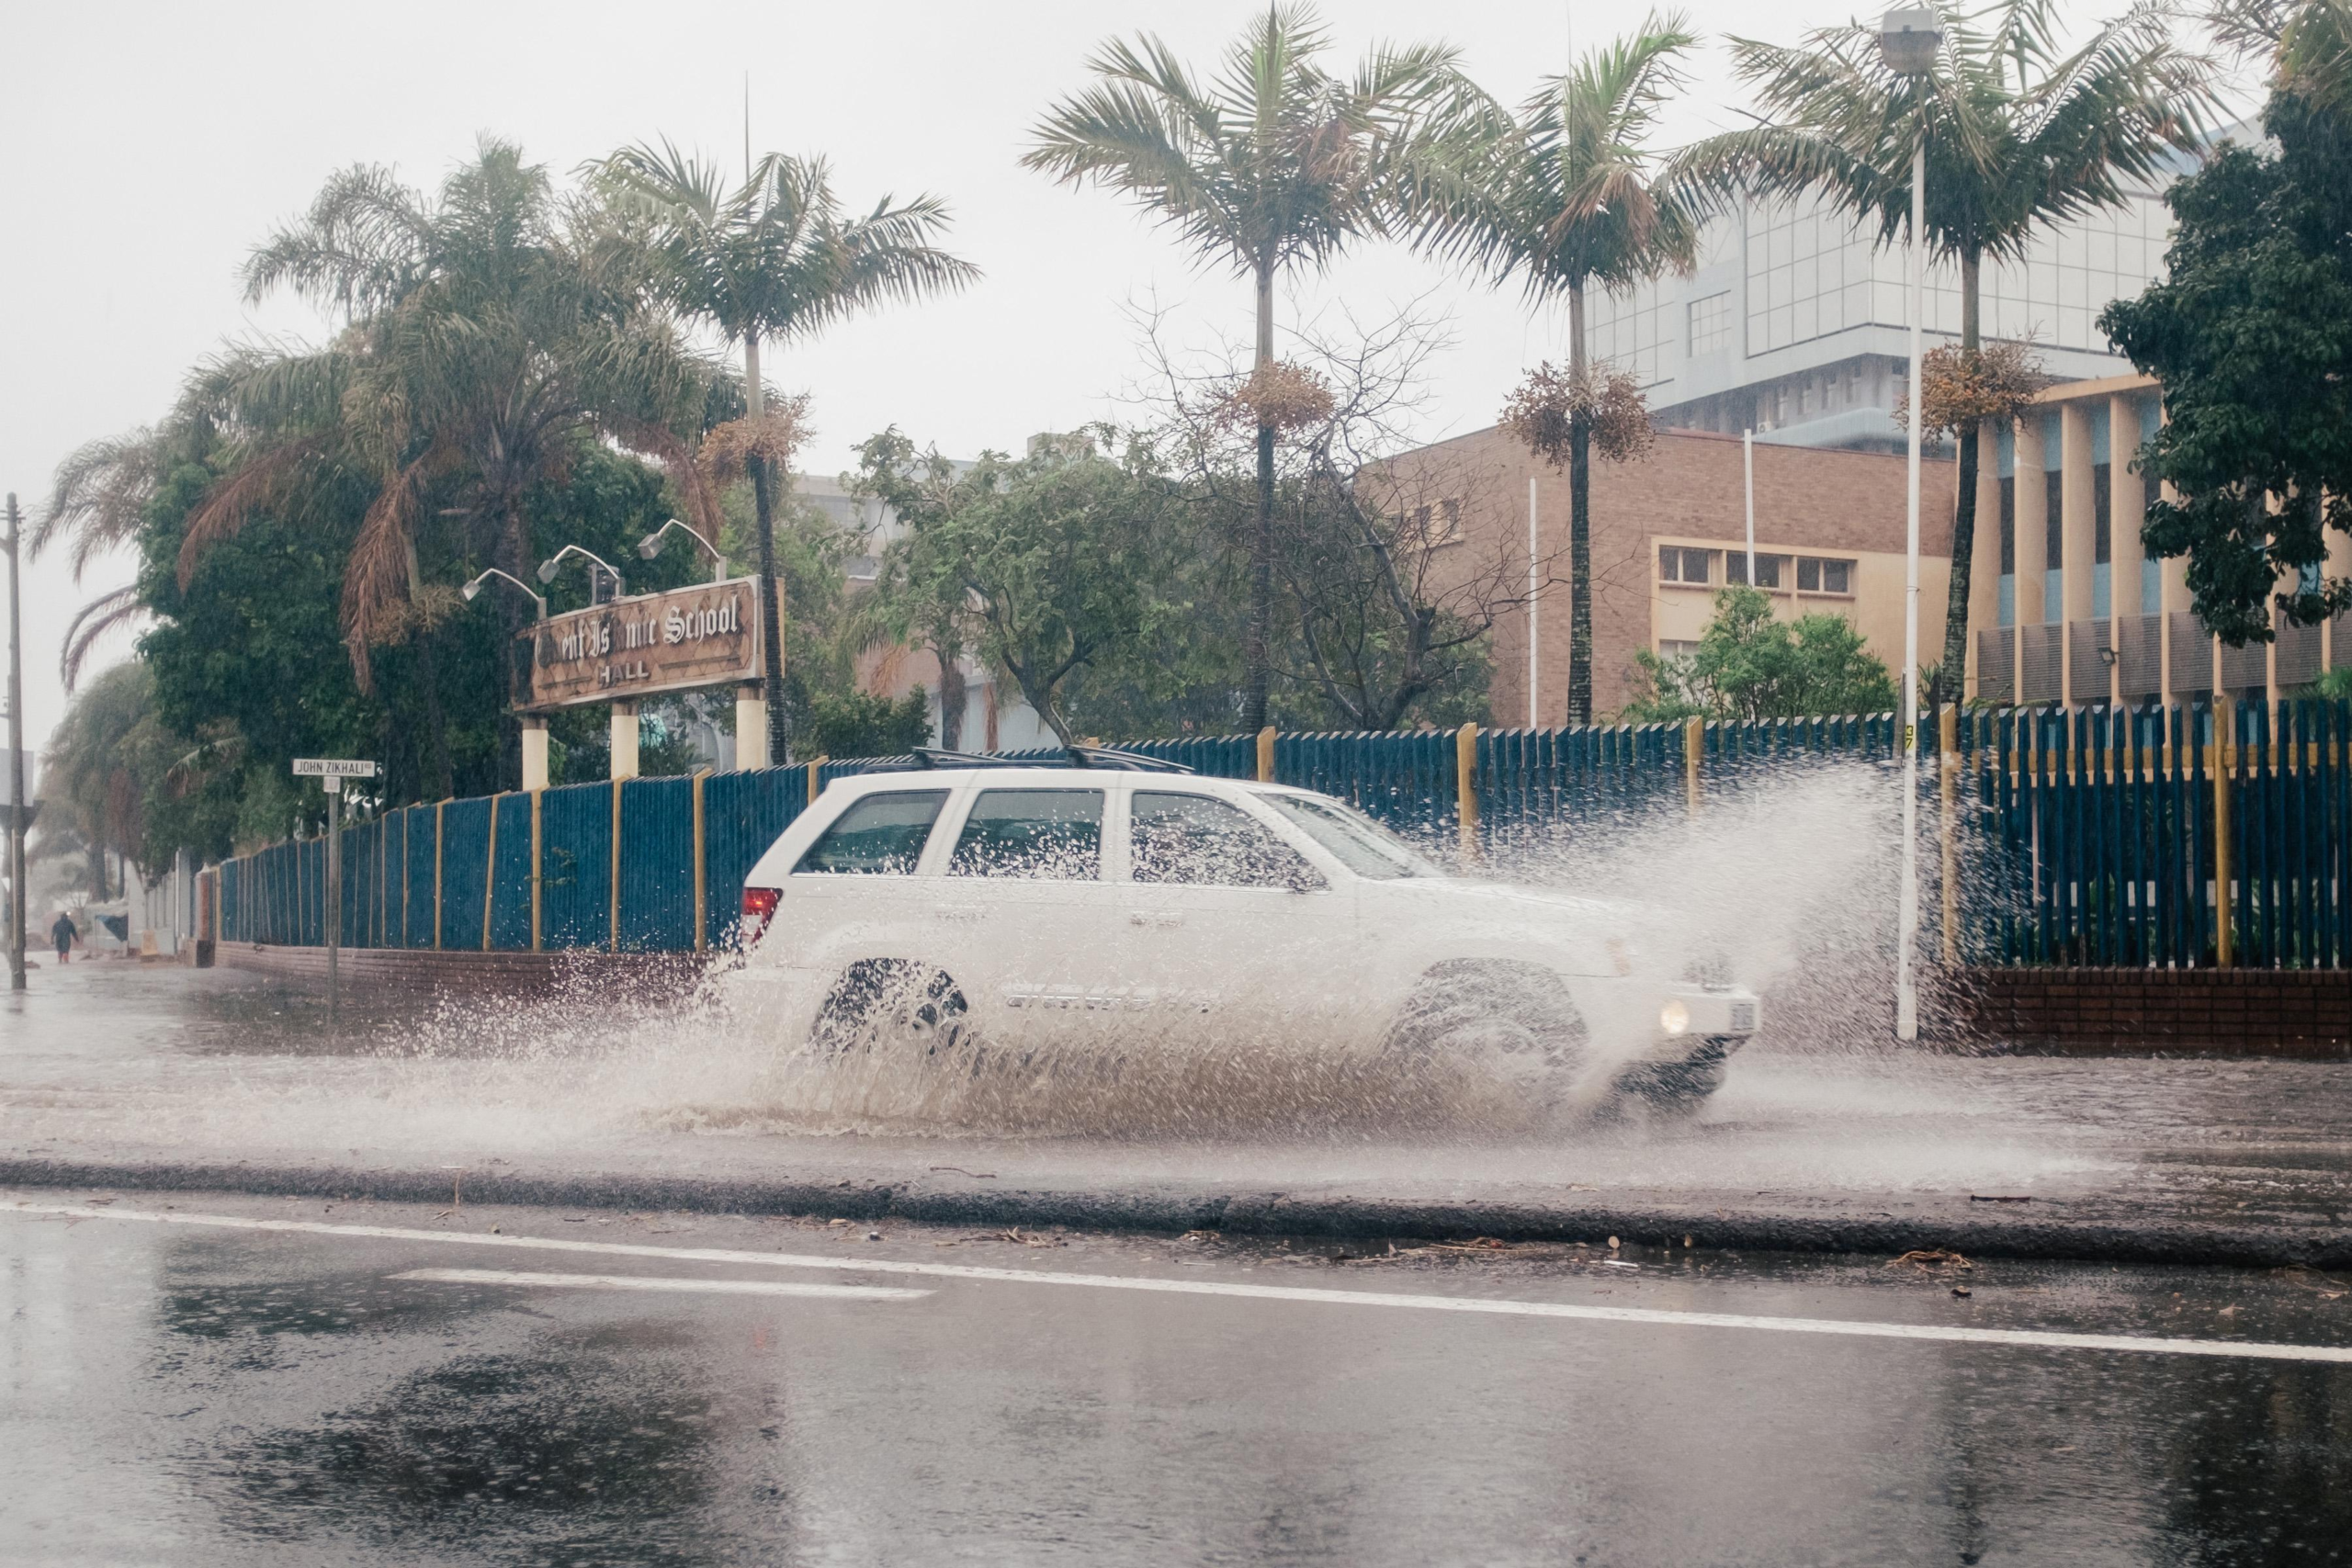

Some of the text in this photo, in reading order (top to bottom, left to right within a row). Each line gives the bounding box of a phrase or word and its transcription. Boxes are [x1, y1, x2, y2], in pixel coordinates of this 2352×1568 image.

[663, 594, 737, 645] School
[599, 660, 649, 687] HALL
[298, 761, 322, 773] JOHN
[326, 761, 364, 774] ZIKHALI
